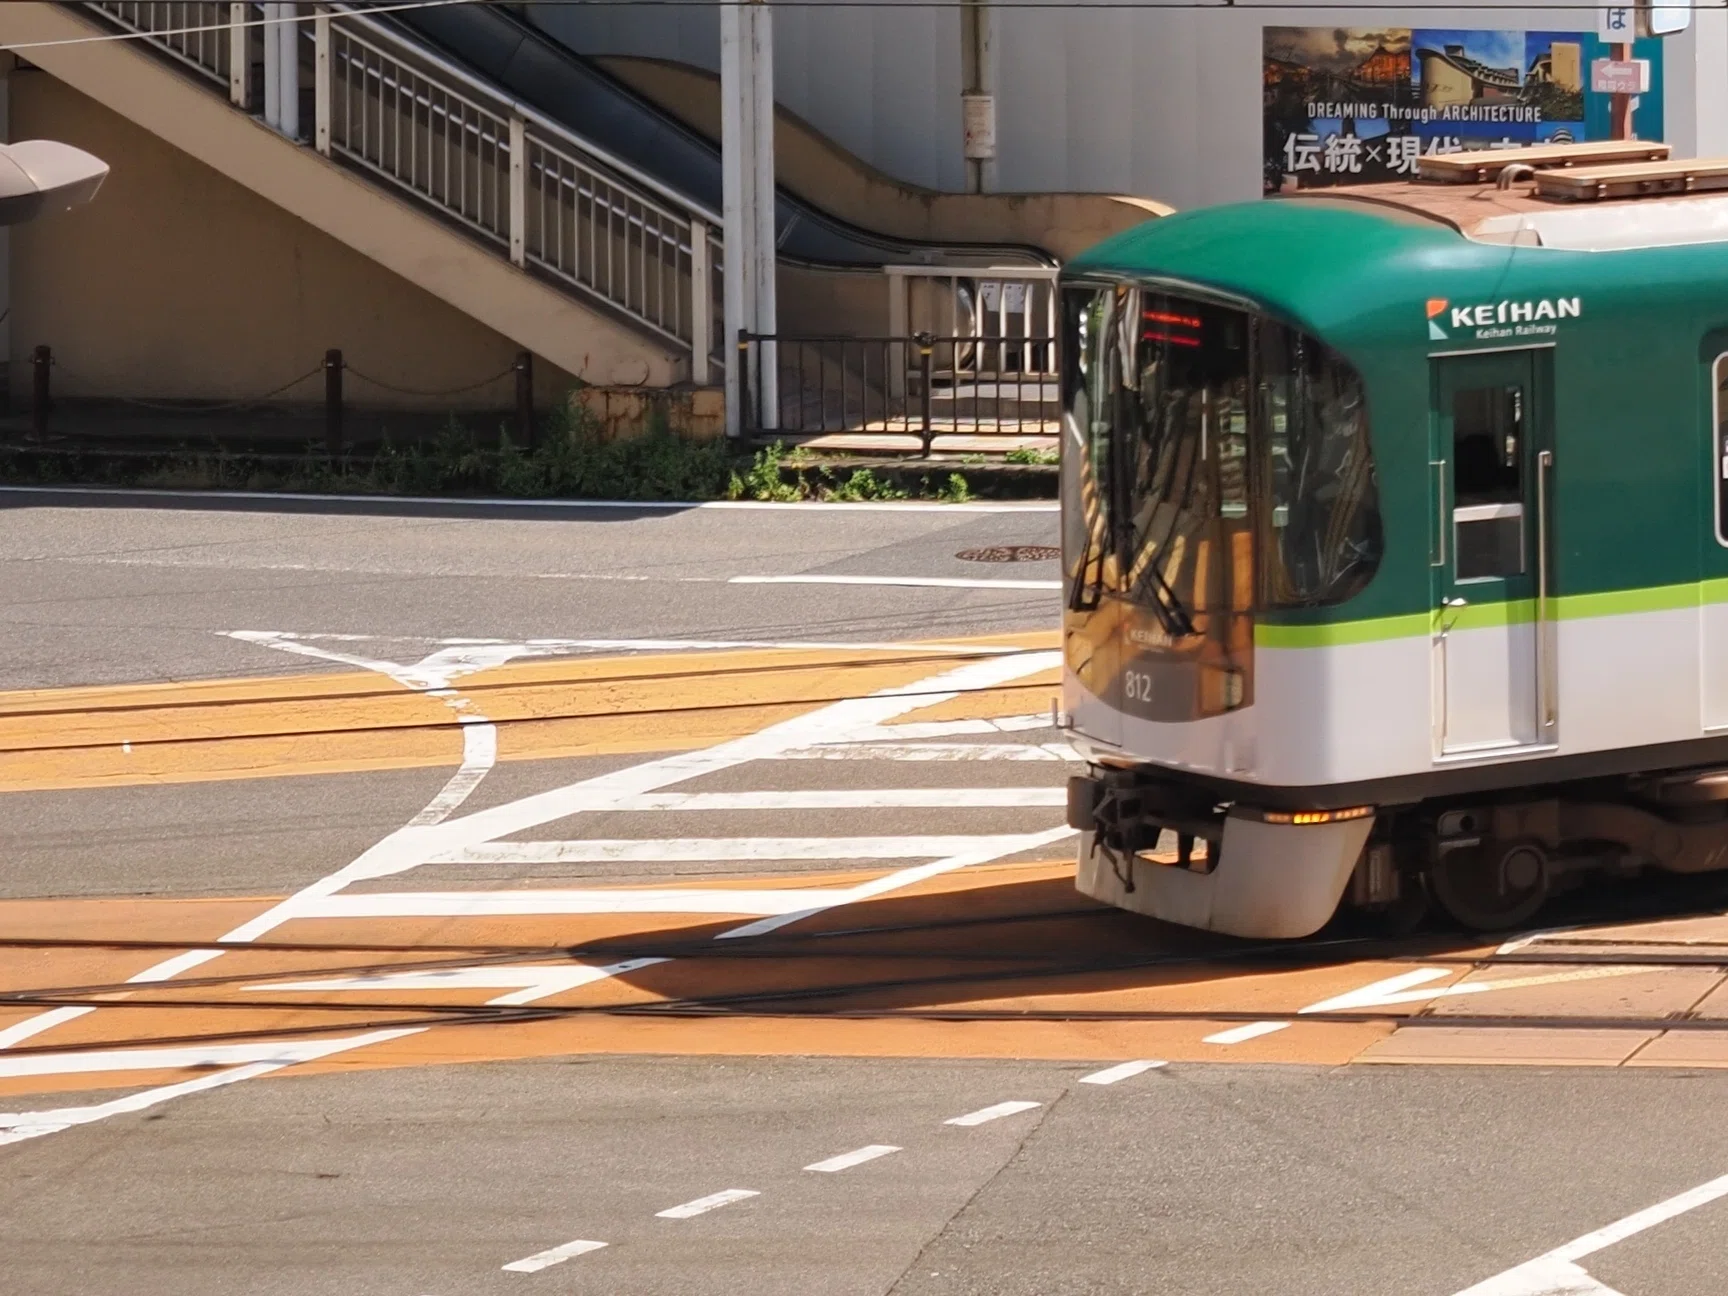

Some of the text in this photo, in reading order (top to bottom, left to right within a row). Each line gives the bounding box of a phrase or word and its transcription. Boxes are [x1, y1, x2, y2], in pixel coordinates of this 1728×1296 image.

[1307, 102, 1542, 123] DREAMING Through ARCHITECTURE
[1451, 297, 1581, 328] KEIHAN
[1475, 324, 1557, 339] Keihan Railway
[1125, 670, 1153, 703] 812
